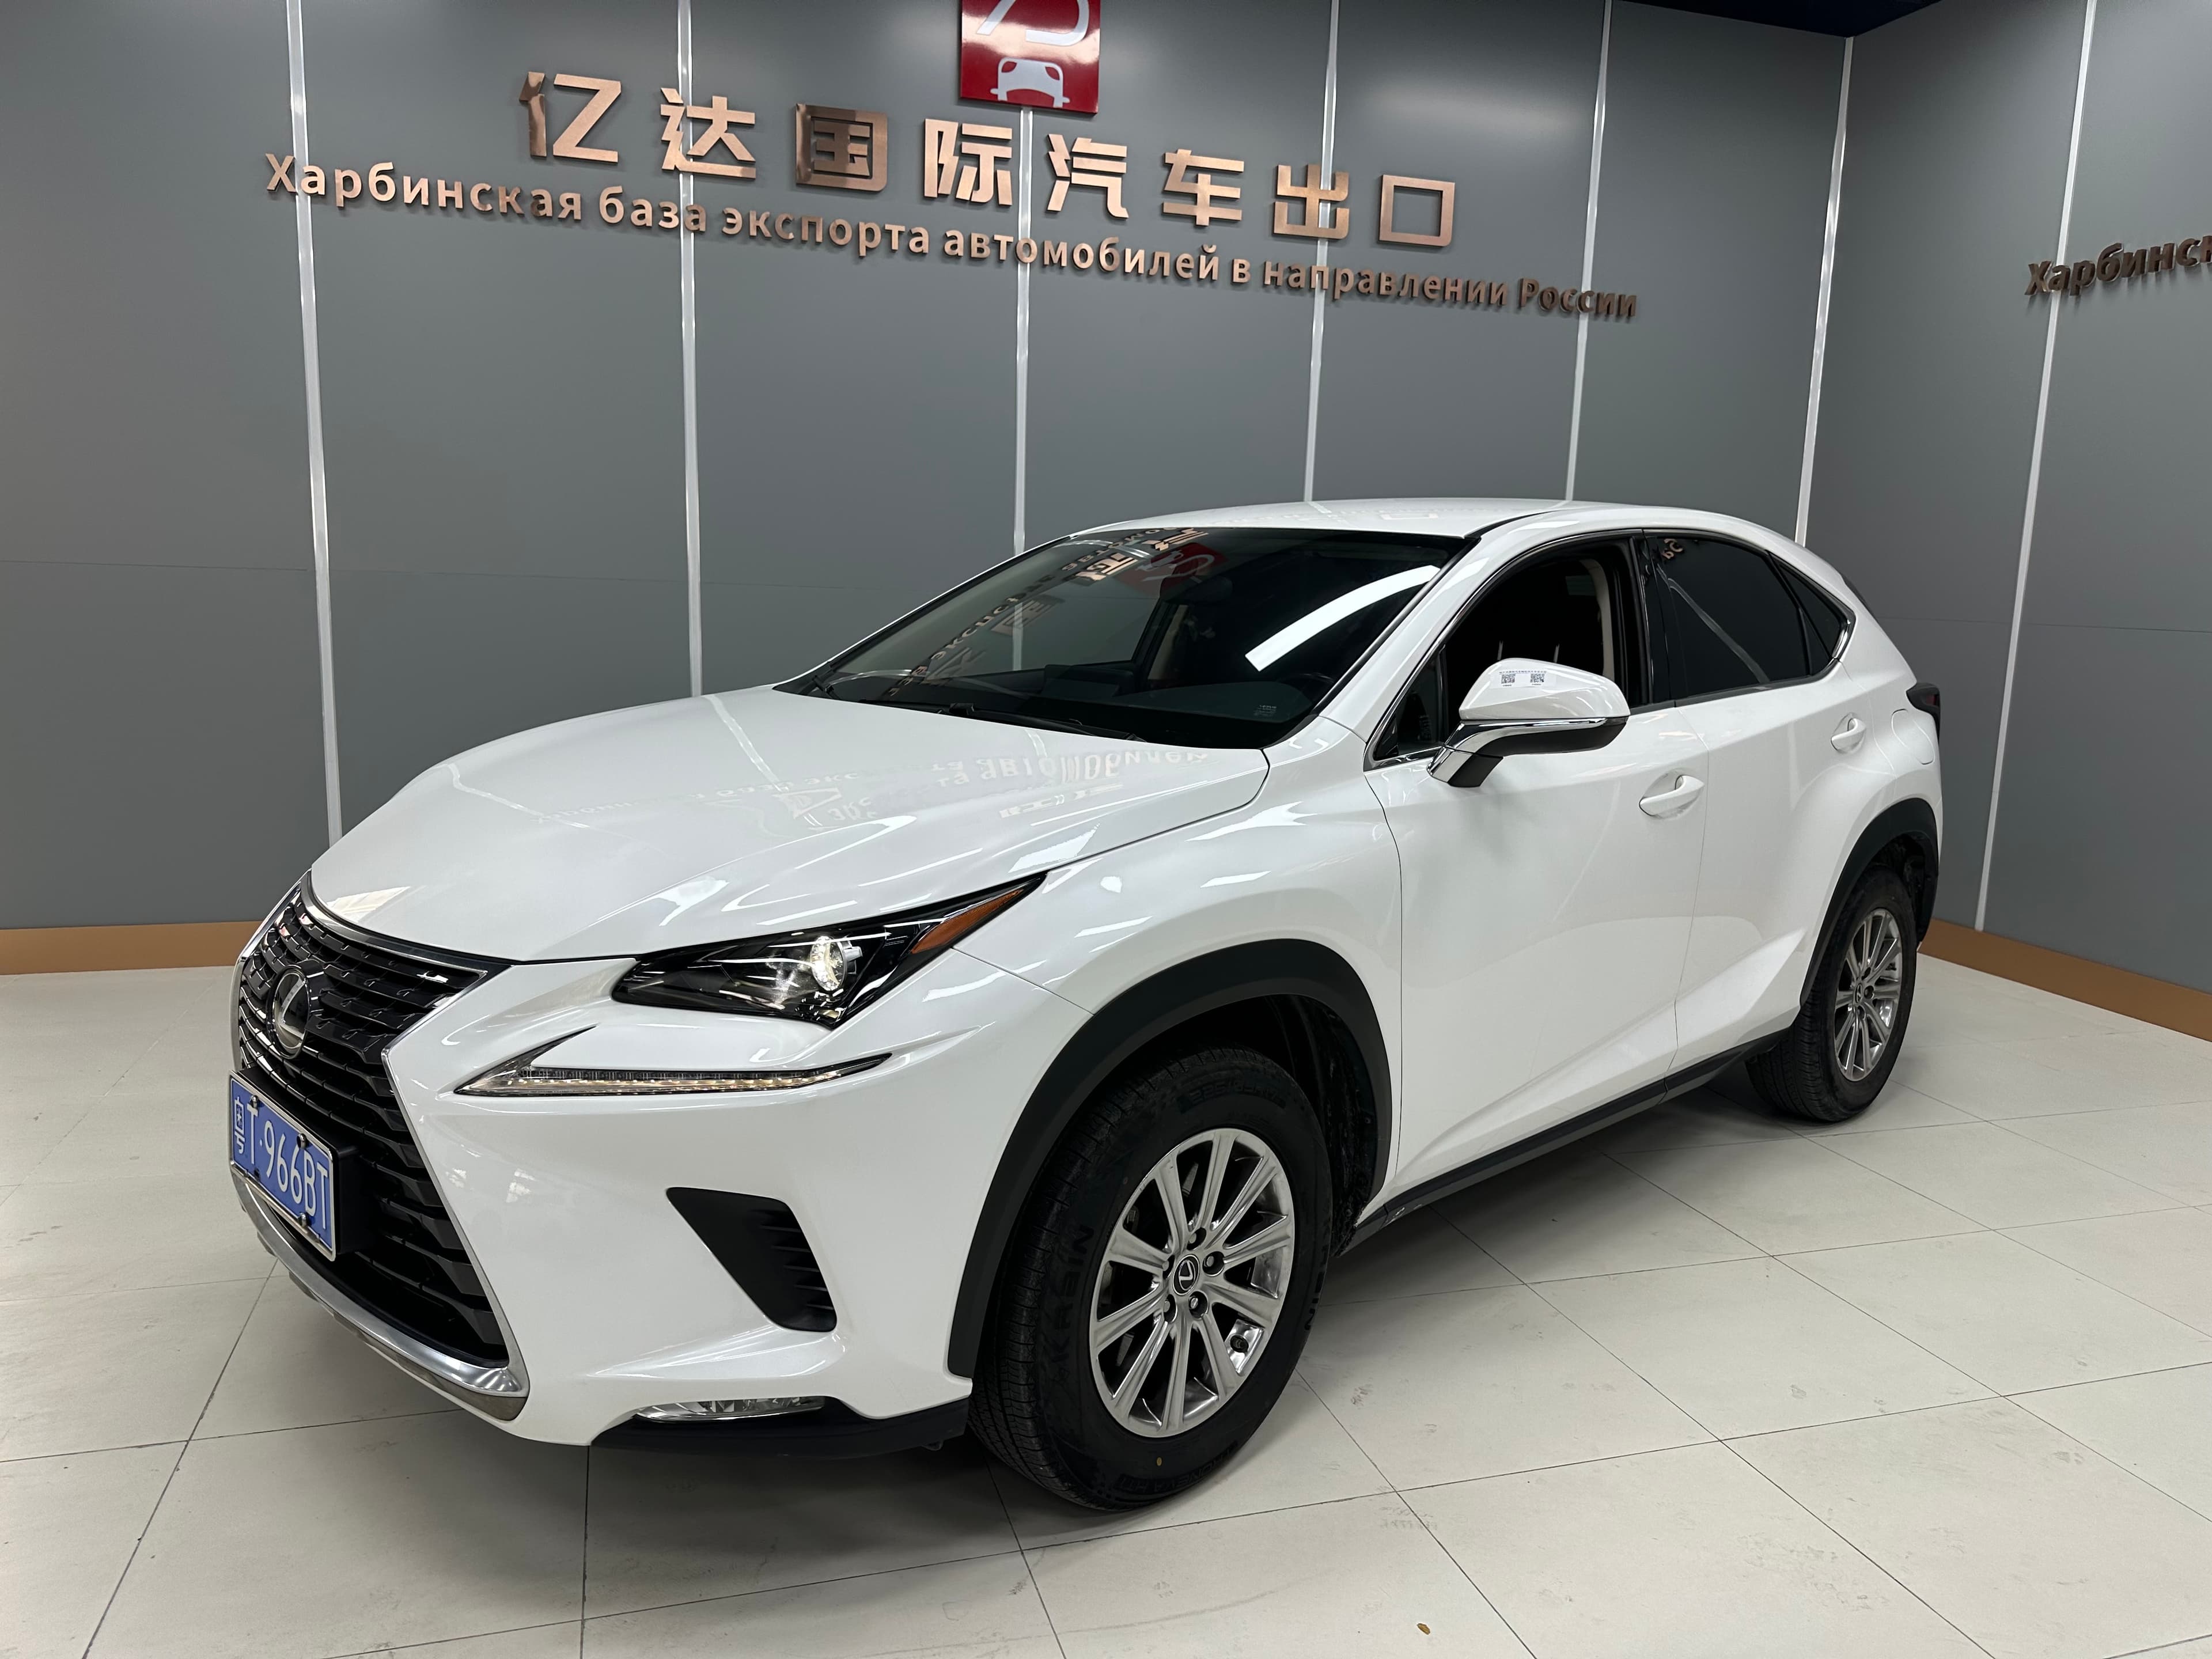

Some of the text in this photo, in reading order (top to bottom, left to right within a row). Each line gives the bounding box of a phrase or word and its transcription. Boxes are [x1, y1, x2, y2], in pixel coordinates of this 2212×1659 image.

[265, 153, 1638, 318] Харбинская база экспорта автомобилей в направлении России
[520, 71, 1455, 248] 亿达国际汽车出口
